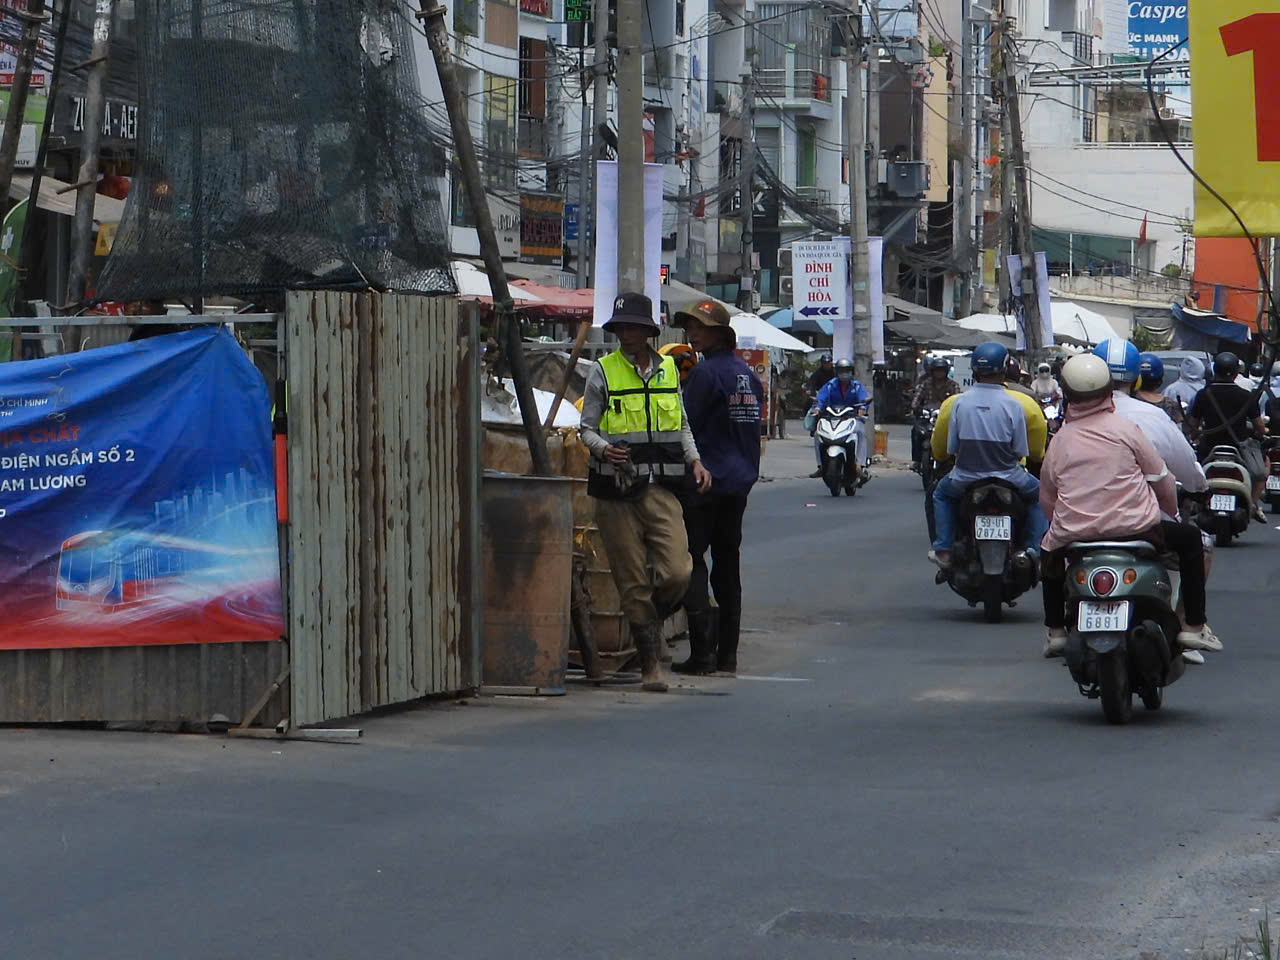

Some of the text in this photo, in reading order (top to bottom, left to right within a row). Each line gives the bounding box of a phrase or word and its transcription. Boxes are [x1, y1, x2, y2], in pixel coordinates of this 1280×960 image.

[1144, 34, 1179, 46] MẠNH
[805, 260, 832, 273] ĐÌNH
[809, 274, 829, 287] CHÍ
[808, 289, 832, 302] HÒA
[24, 398, 48, 407] MINH
[1, 452, 40, 472] ĐIỆN
[45, 448, 93, 467] NGẦM
[98, 444, 120, 463] SỐ
[125, 449, 135, 462] 2
[30, 474, 86, 490] LƯƠNG
